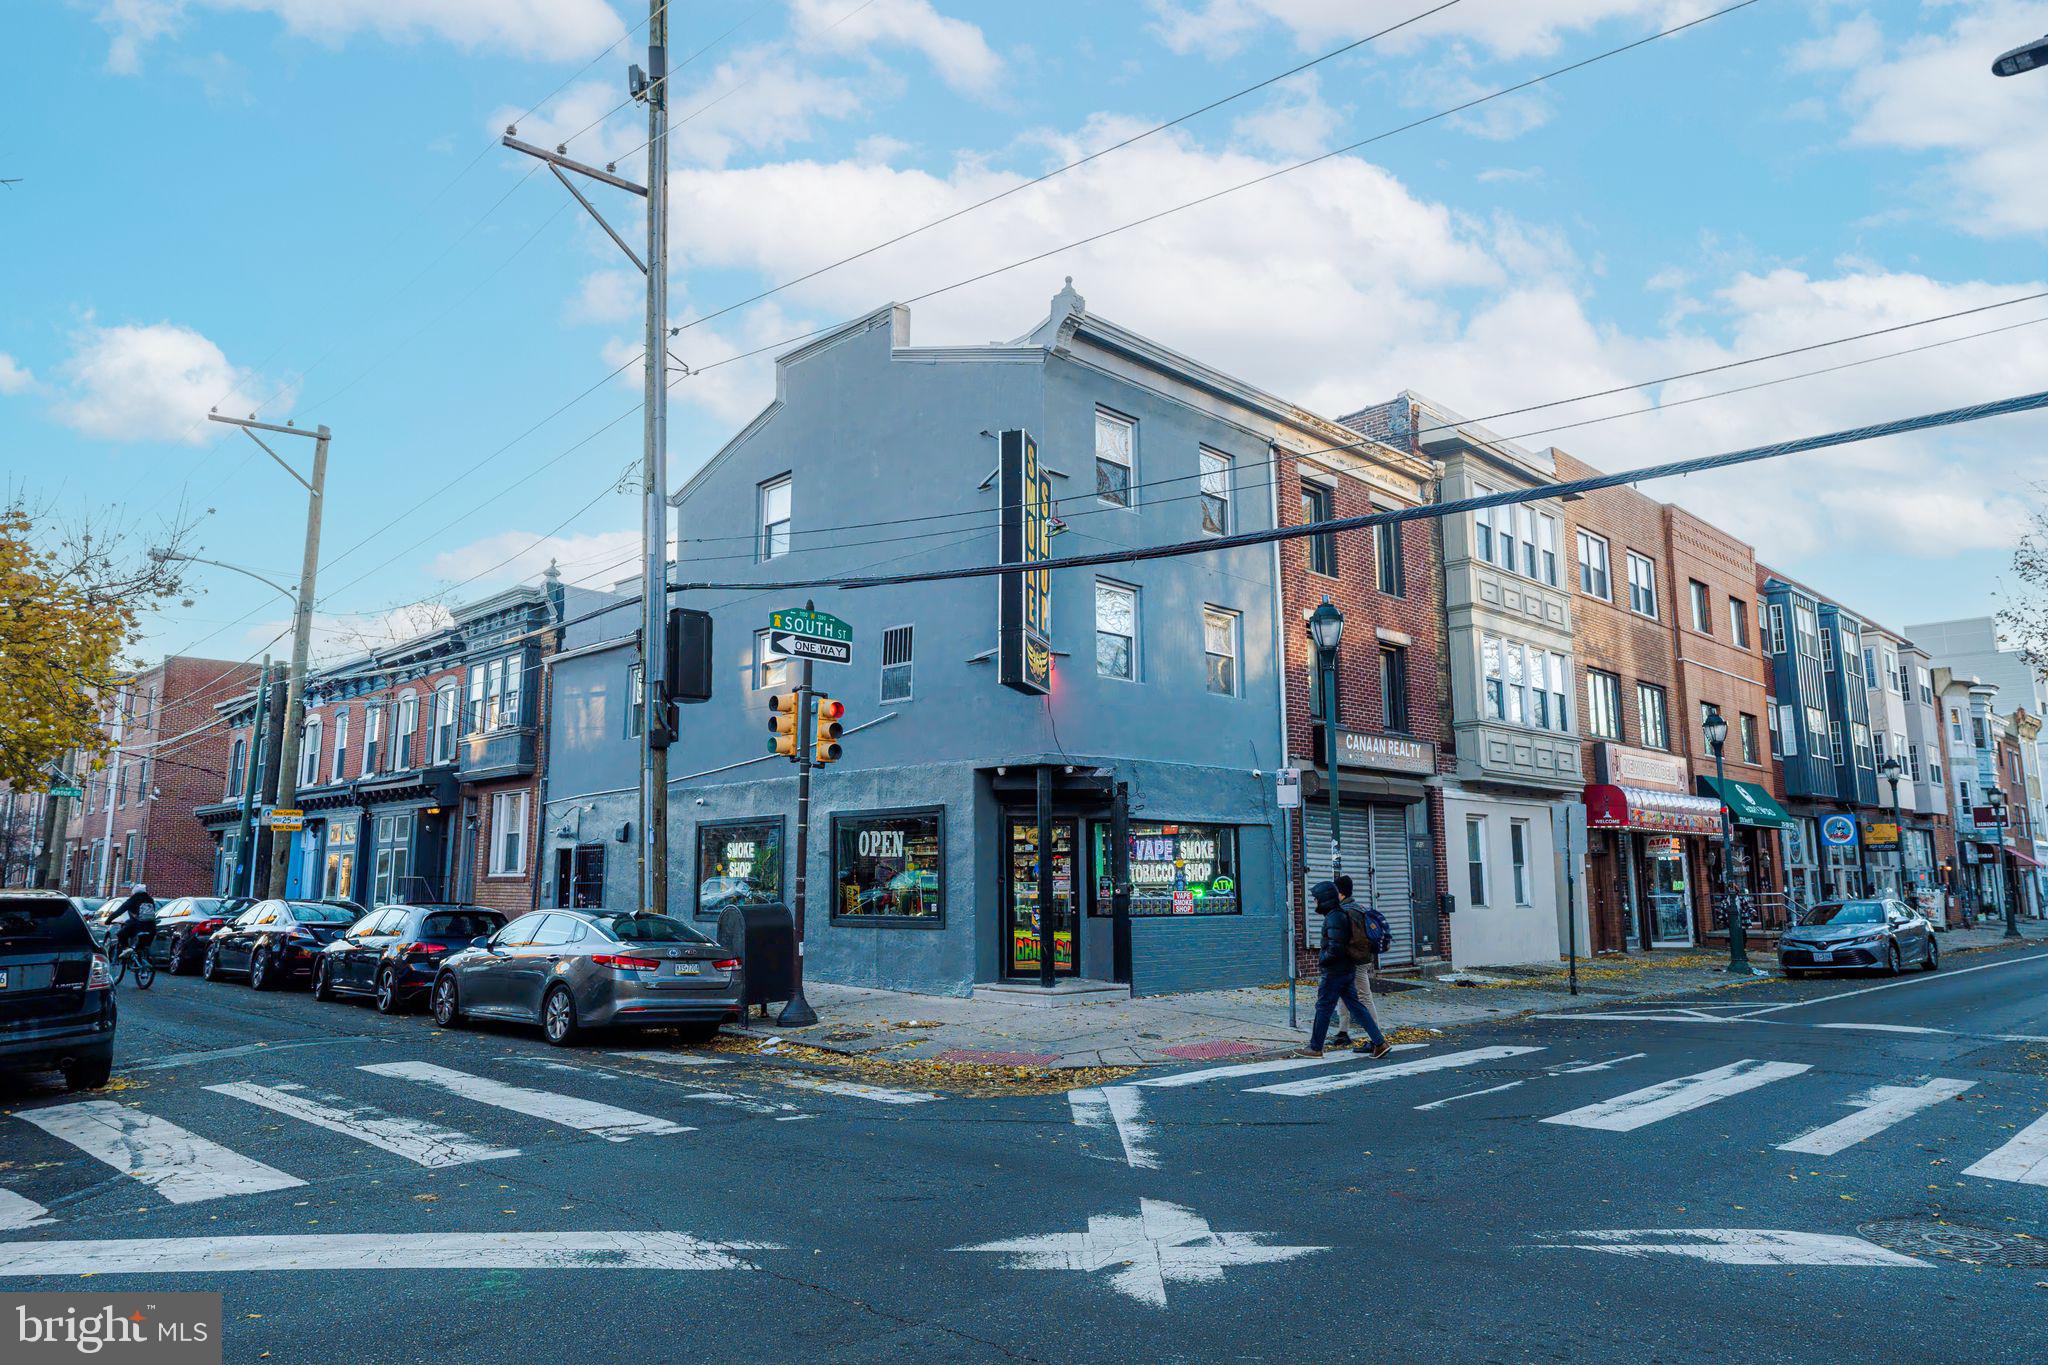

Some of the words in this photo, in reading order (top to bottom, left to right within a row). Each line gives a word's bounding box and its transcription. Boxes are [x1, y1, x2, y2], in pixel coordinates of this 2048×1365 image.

[1026, 444, 1036, 624] SMOKE
[785, 616, 833, 637] SOUTH
[837, 629, 847, 640] ST
[795, 641, 817, 653] ONE
[820, 645, 843, 657] WAY
[1346, 734, 1386, 754] CANAAN
[1388, 740, 1421, 758] REALTY
[282, 816, 292, 824] 25
[727, 842, 755, 859] SMOKE
[859, 830, 904, 858] OPEN
[1136, 840, 1173, 860] VAPE
[1180, 840, 1214, 860] SMOKE
[1648, 838, 1670, 846] ATM
[728, 861, 752, 878] SHOP
[1129, 862, 1176, 883] TOBACCO
[1184, 862, 1211, 882] SHOP
[1212, 879, 1234, 891] ATM
[1175, 891, 1191, 900] VAPE
[1175, 905, 1192, 913] SHOP
